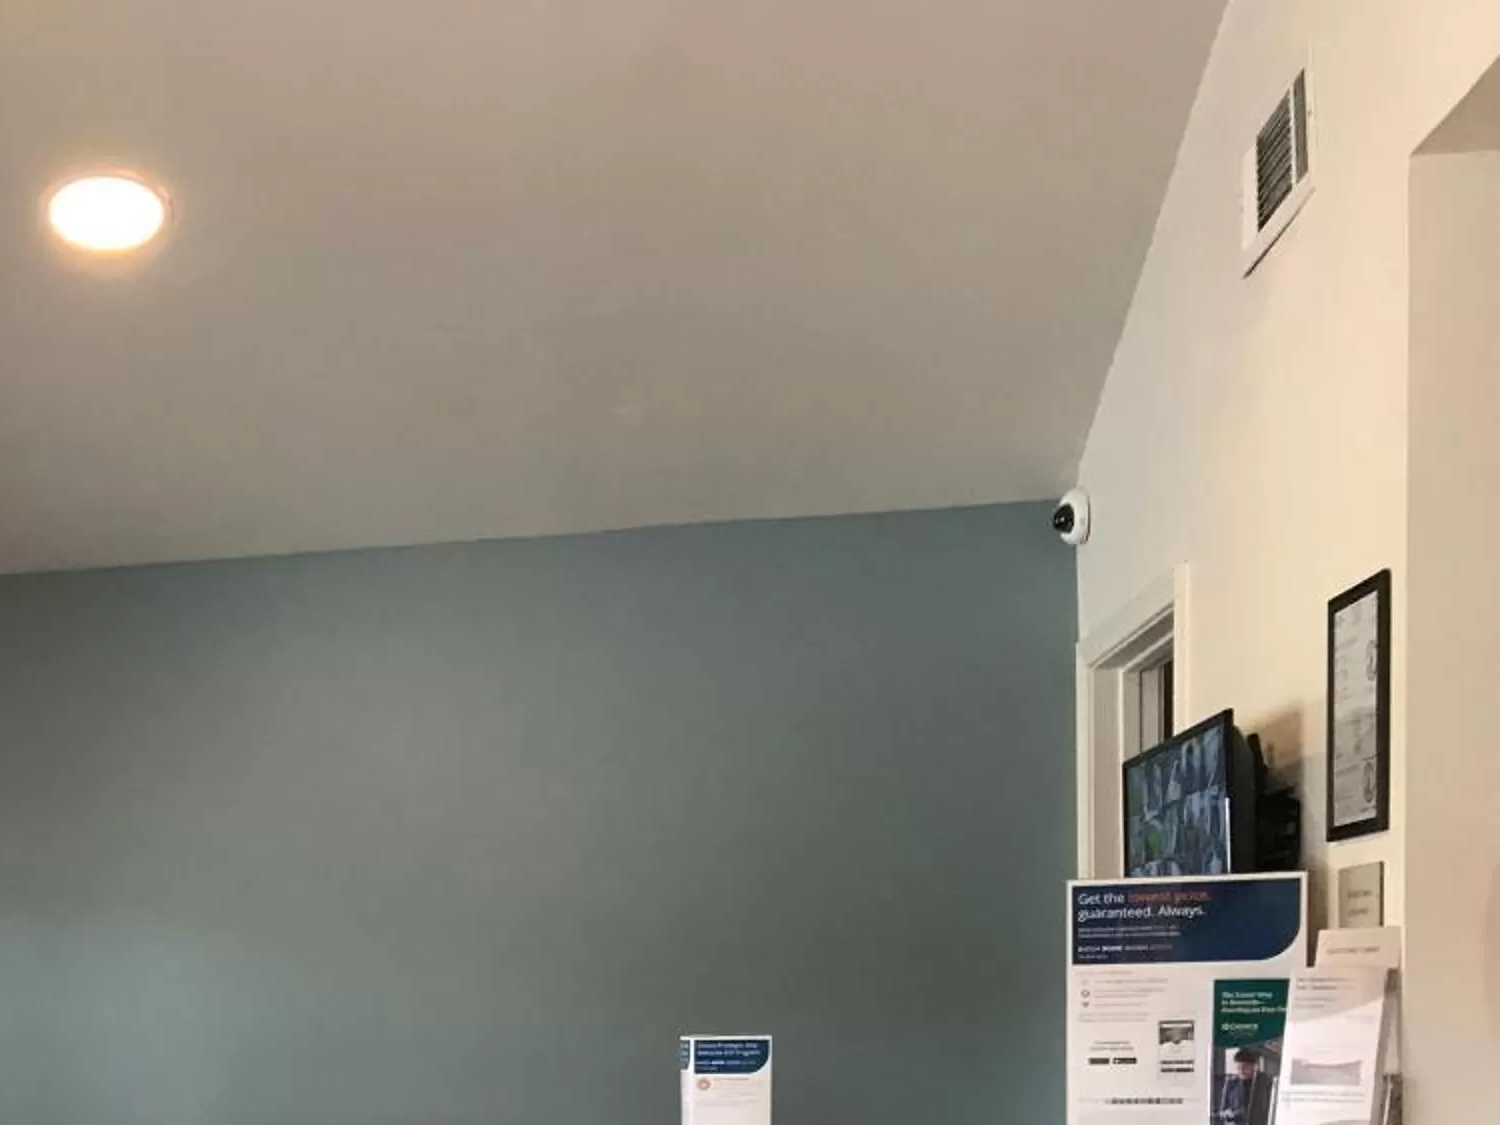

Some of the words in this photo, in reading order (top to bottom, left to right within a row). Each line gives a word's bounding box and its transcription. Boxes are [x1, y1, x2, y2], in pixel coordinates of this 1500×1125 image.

[1077, 893, 1100, 904] Get
[1103, 892, 1125, 903] the
[1077, 906, 1153, 922] guaranteed.
[1158, 904, 1206, 919] Always.
